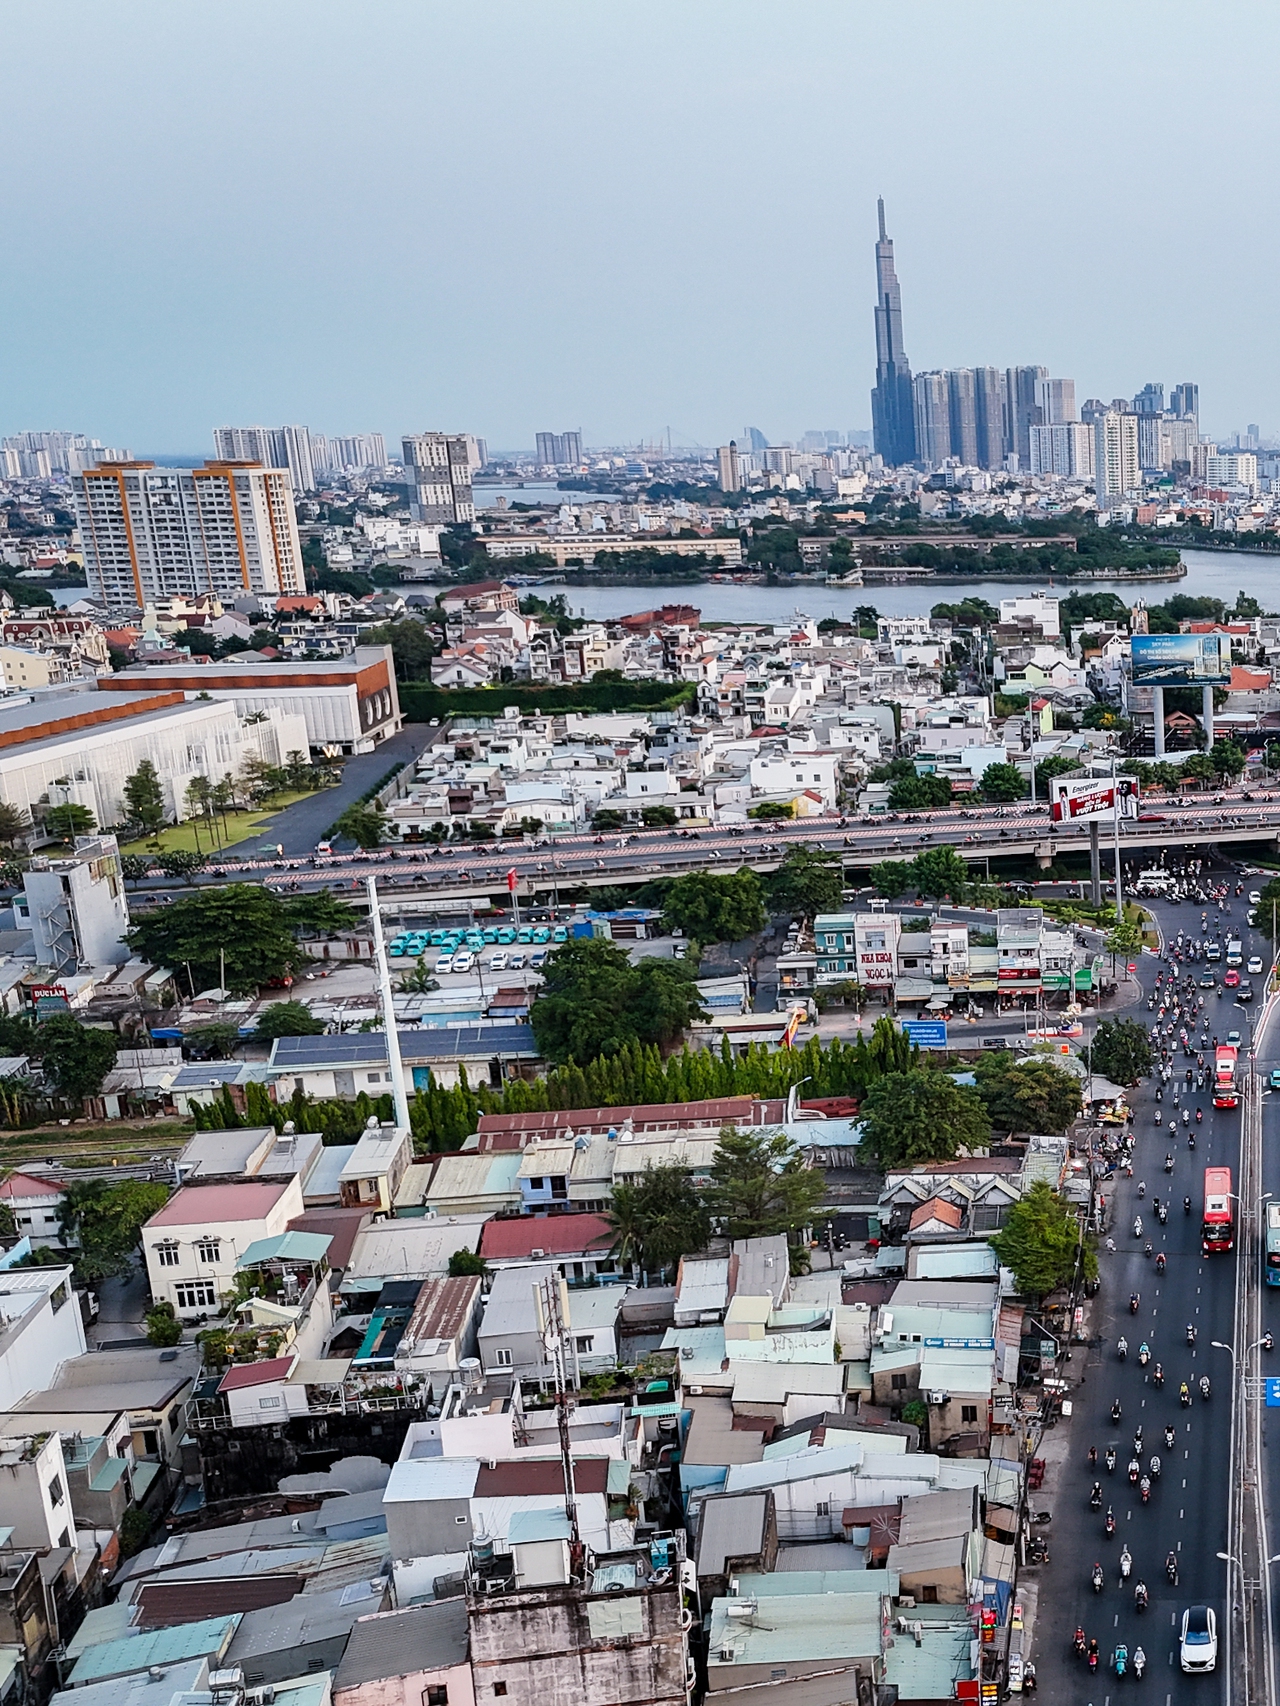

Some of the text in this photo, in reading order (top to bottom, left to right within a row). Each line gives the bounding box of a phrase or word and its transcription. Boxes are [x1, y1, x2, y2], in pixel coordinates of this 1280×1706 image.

[1072, 782, 1099, 793] Energizer
[861, 953, 893, 963] NHA KHOA
[865, 968, 885, 981] NGỌC
